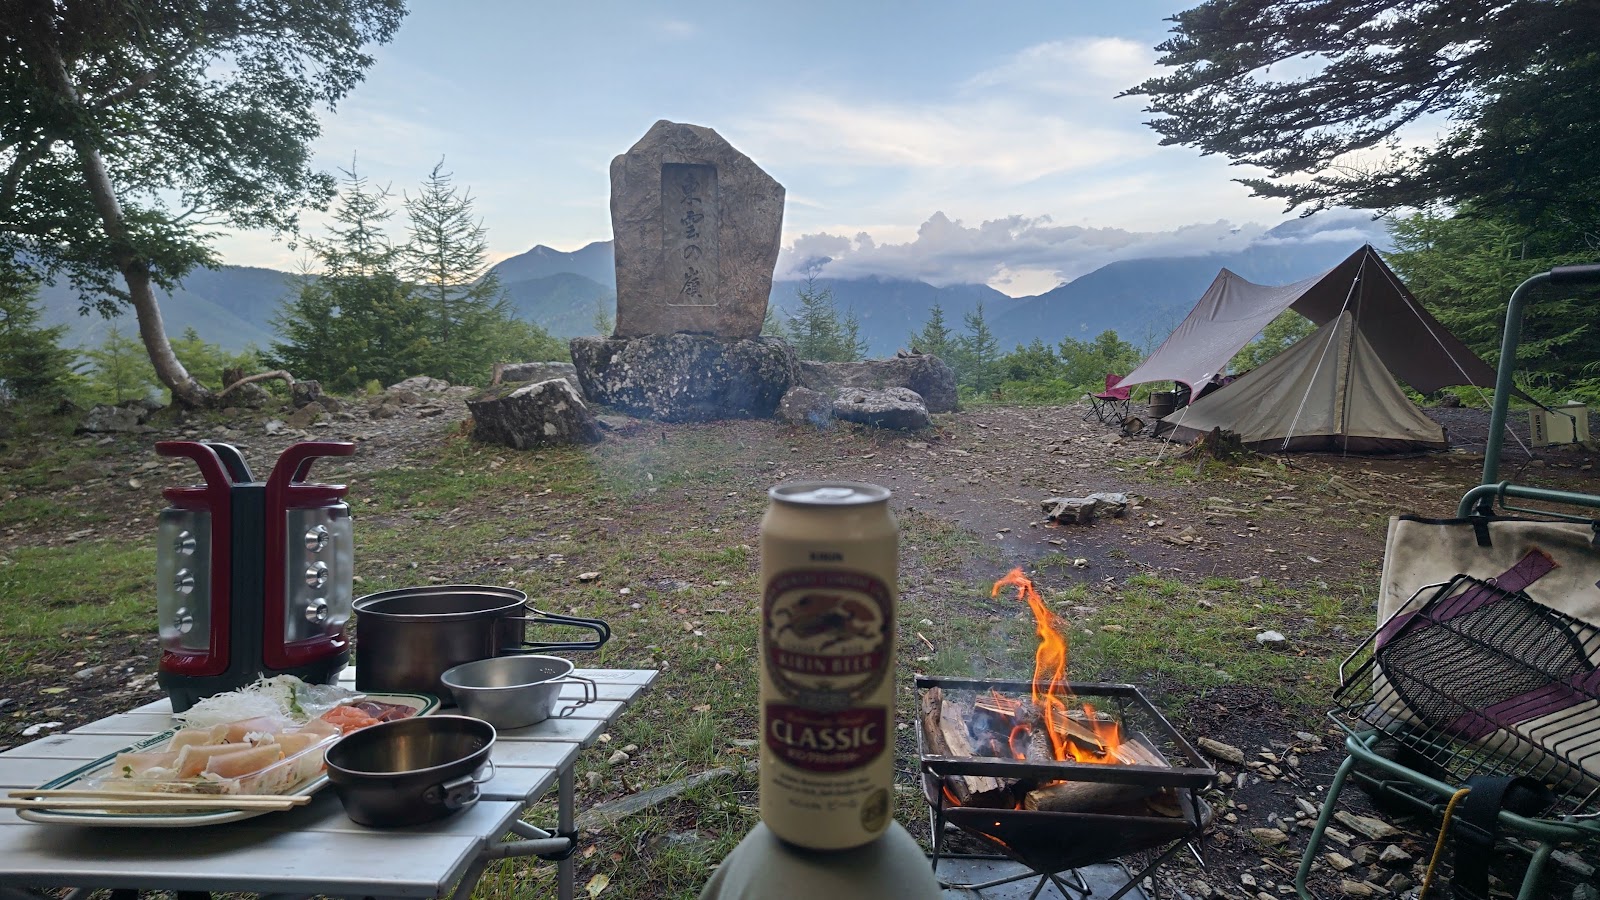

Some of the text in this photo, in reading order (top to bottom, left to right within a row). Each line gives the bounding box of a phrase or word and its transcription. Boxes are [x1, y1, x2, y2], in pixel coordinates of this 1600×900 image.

[778, 653, 873, 674] KIRIN BEER
[770, 718, 878, 751] CLASSIC
